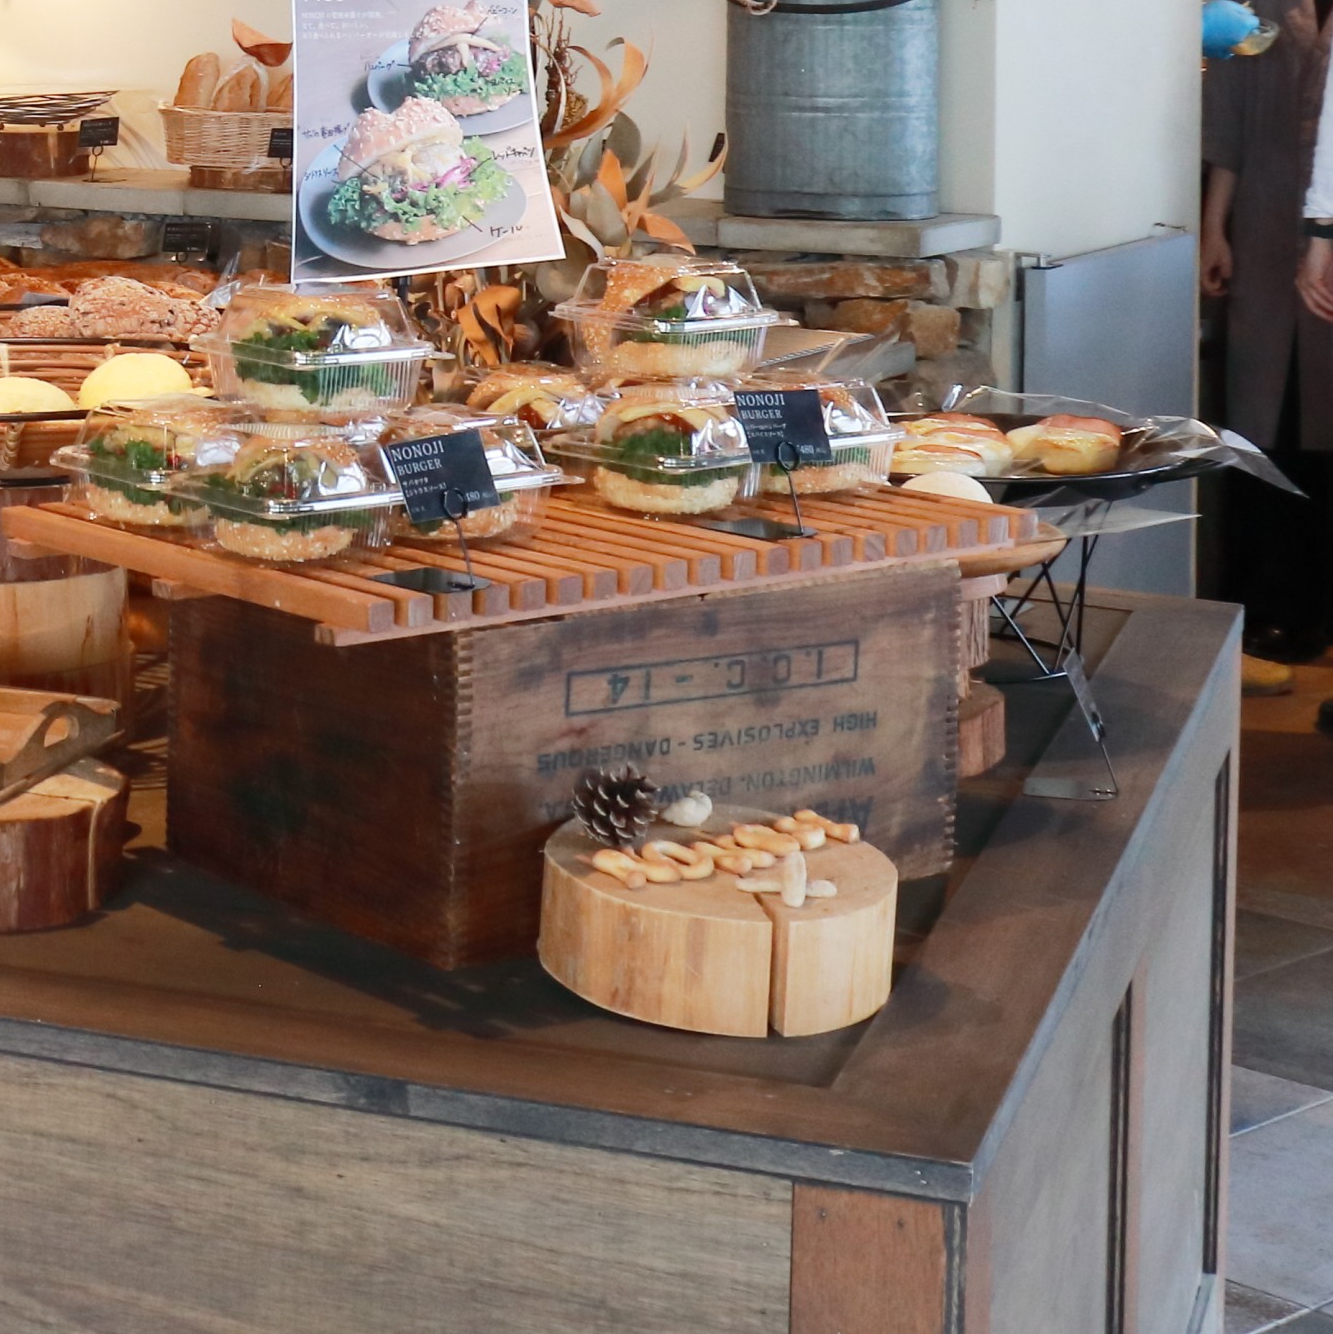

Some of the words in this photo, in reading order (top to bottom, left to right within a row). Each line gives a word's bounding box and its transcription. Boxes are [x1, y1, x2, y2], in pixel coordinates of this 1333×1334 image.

[735, 394, 786, 407] NONOJI
[741, 409, 783, 420] BURGER
[391, 440, 445, 462] NONOJI
[396, 458, 443, 476] BURGER
[833, 711, 877, 733] HIGH
[693, 717, 821, 752] EXPLOSIVES
[537, 736, 671, 773] DANGEROUS
